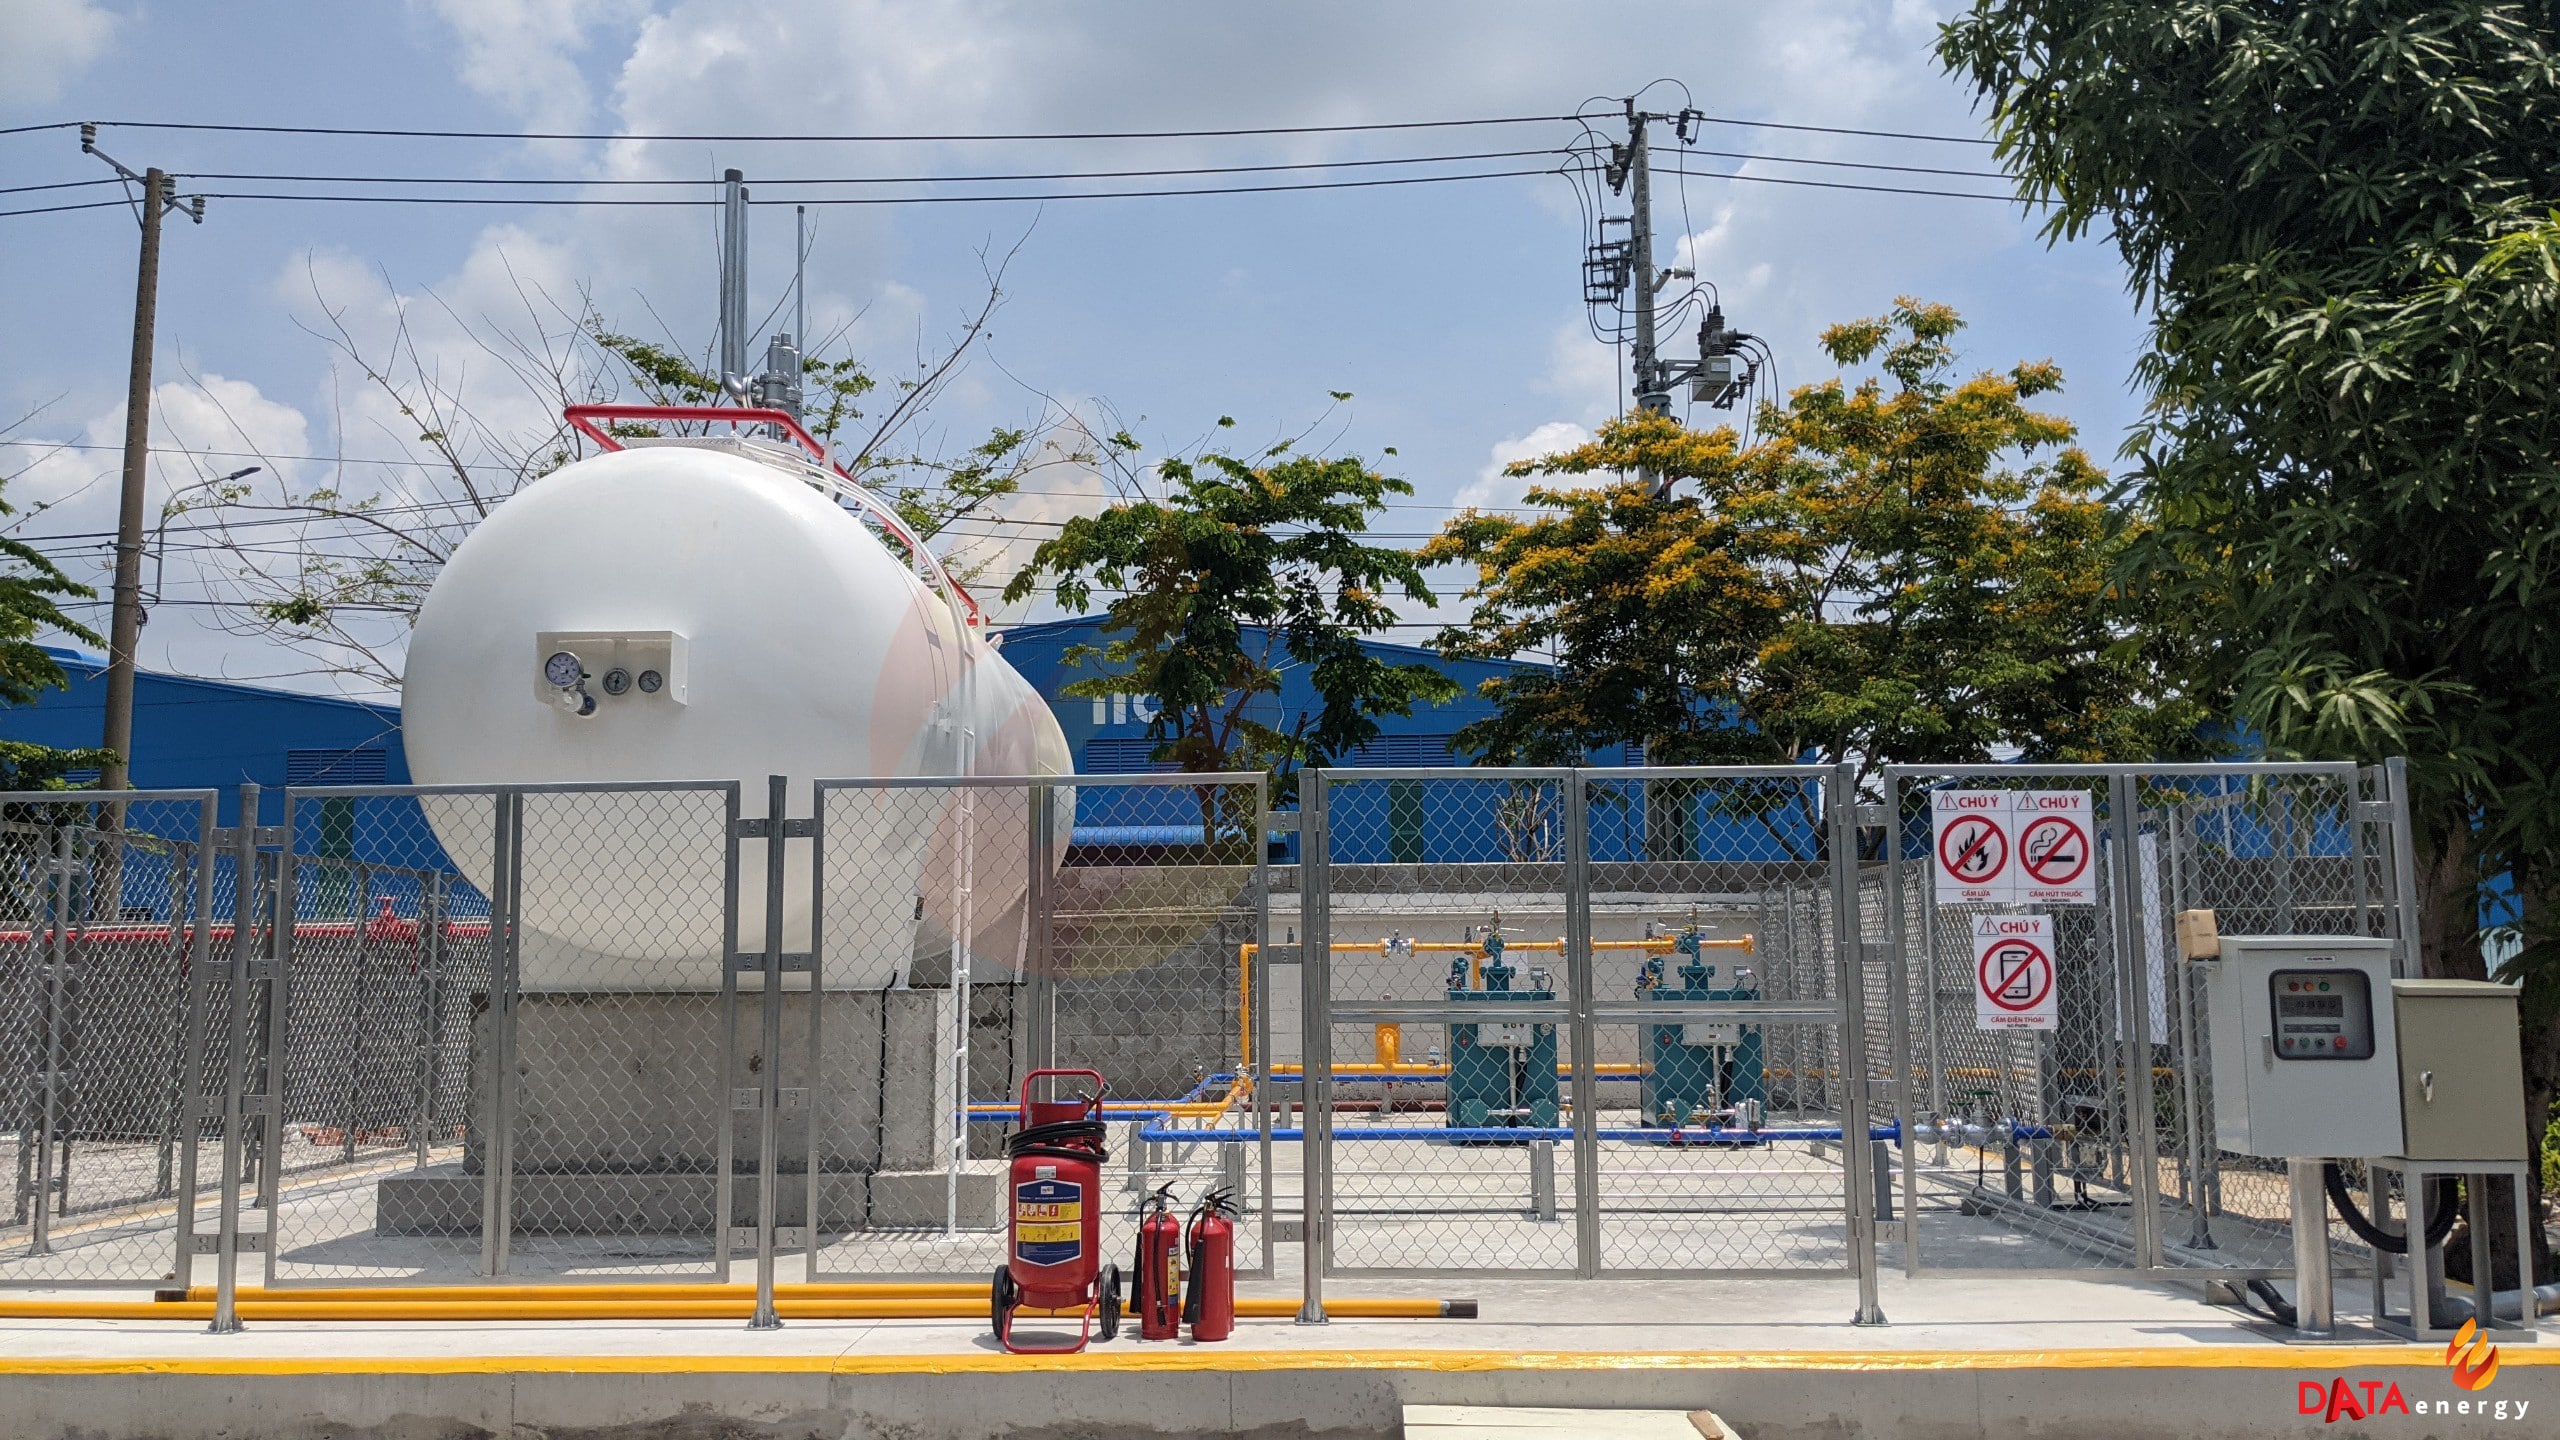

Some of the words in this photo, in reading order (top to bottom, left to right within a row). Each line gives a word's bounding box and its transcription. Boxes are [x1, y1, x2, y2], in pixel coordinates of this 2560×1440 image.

[1959, 794, 1987, 808] CHÚ
[1990, 794, 1999, 808] Ý
[2039, 795, 2068, 809] CHÚ
[2071, 795, 2080, 809] Ý
[1962, 889, 1977, 897] CẤM
[2029, 890, 2044, 898] CẤM
[2046, 889, 2059, 898] HÚT
[2000, 919, 2029, 933] CHÚ
[2031, 919, 2040, 933] Ý
